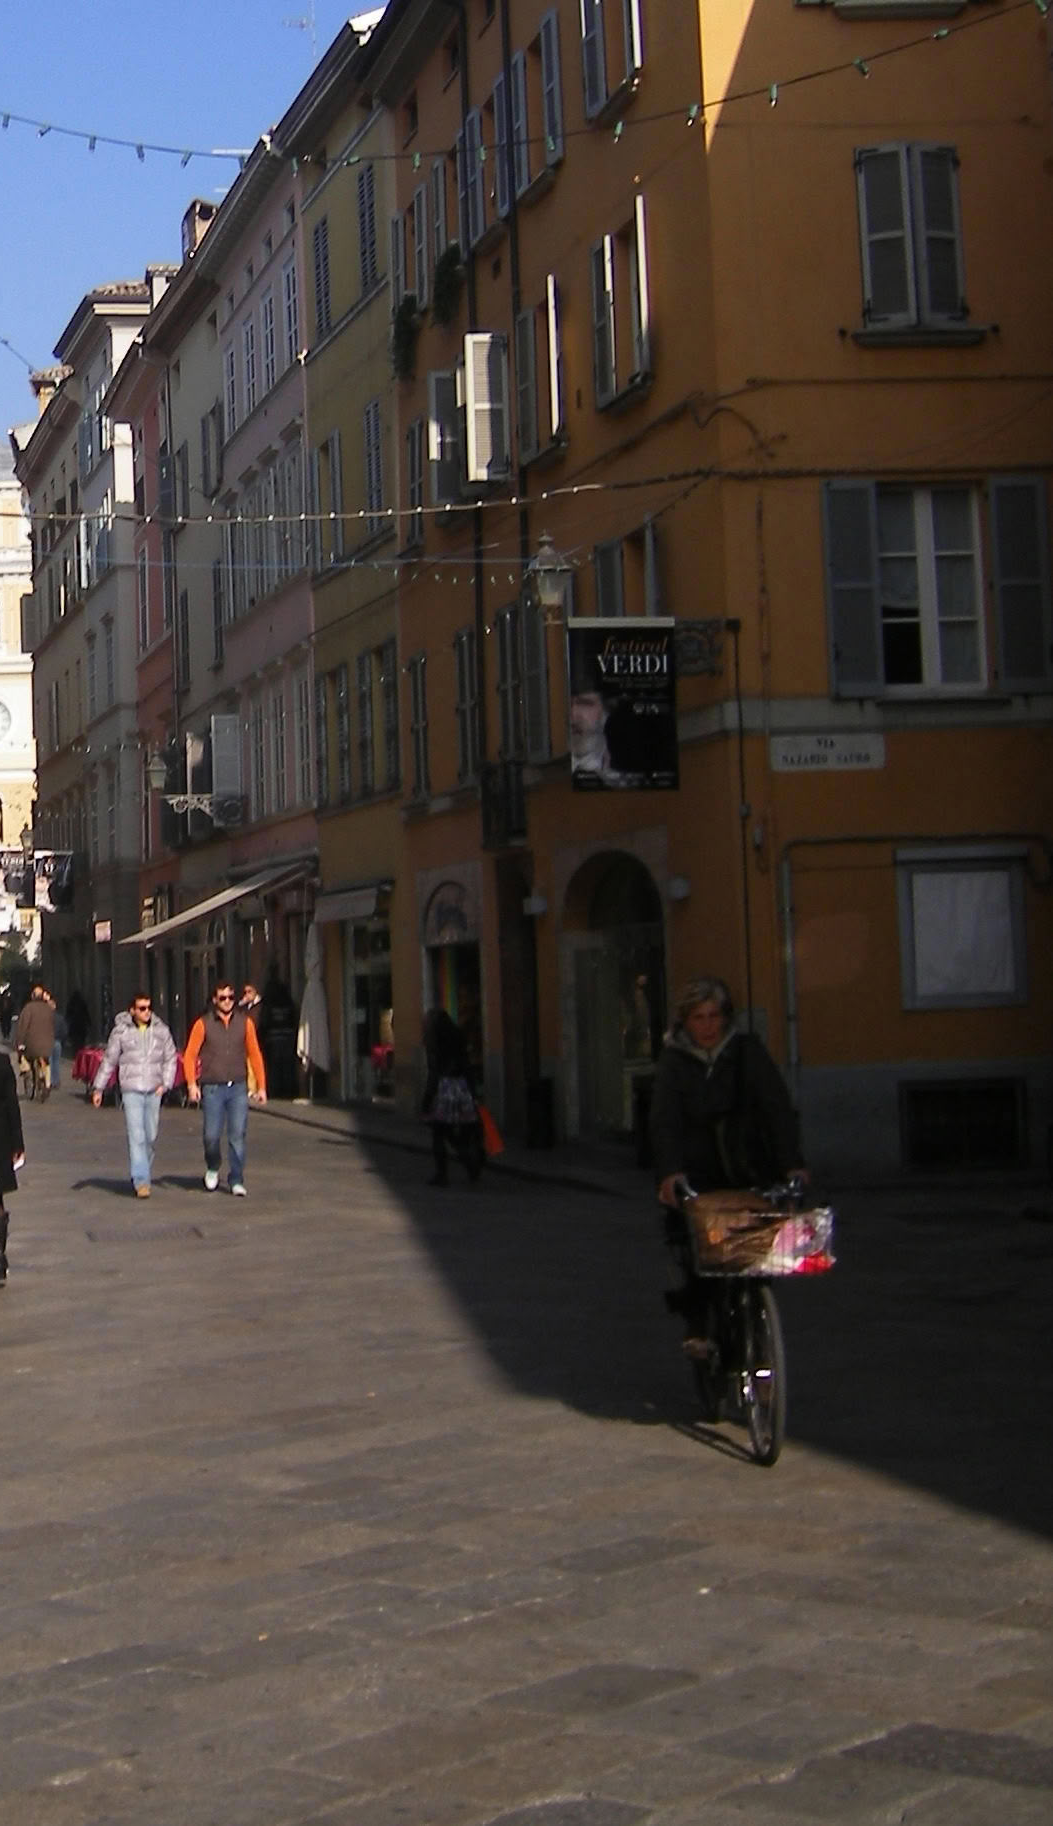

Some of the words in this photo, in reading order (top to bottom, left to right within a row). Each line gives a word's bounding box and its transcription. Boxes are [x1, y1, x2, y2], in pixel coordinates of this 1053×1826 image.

[603, 636, 669, 656] festival
[597, 654, 669, 674] VERDI
[816, 738, 836, 749] VIA
